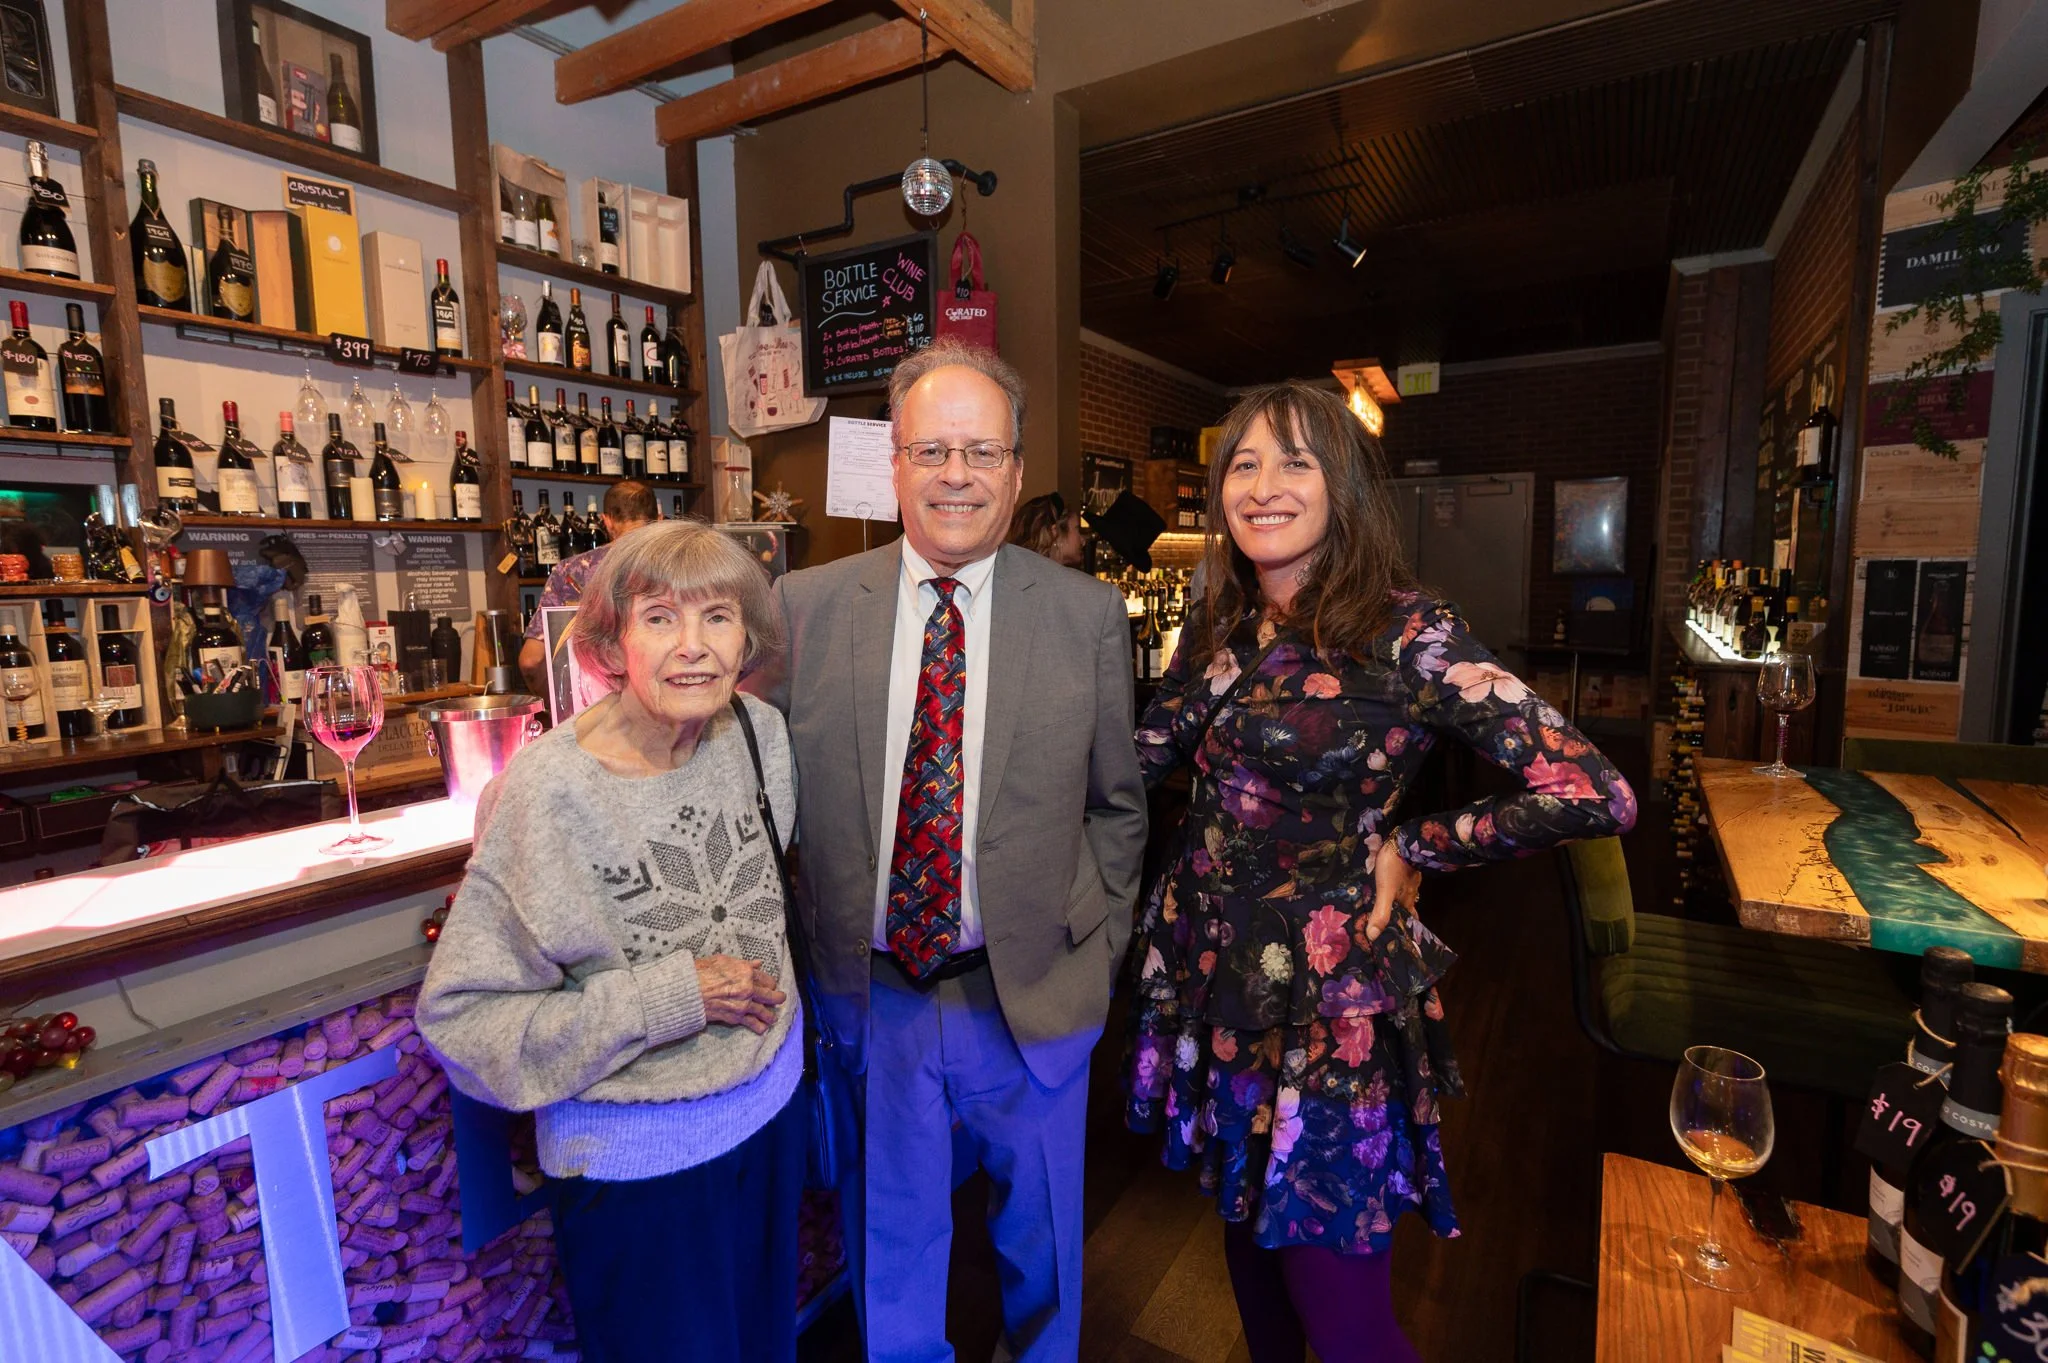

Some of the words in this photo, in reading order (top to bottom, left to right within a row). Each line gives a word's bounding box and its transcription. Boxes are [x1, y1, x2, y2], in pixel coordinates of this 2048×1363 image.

[897, 252, 927, 283] WINE
[1905, 243, 2001, 270] DAMILNO
[824, 262, 878, 290] BOTTLE
[882, 267, 915, 302] CLUB
[822, 283, 878, 314] SERVICE
[335, 336, 371, 360] $399
[405, 350, 431, 367] $75
[1404, 372, 1433, 394] EXIT
[187, 532, 250, 542] WARNING
[328, 533, 369, 541] PENALTIES
[407, 535, 453, 543] WARNING
[1871, 1093, 1923, 1148] $19
[1951, 1110, 1993, 1132] COSTA
[1939, 1174, 1977, 1232] $19
